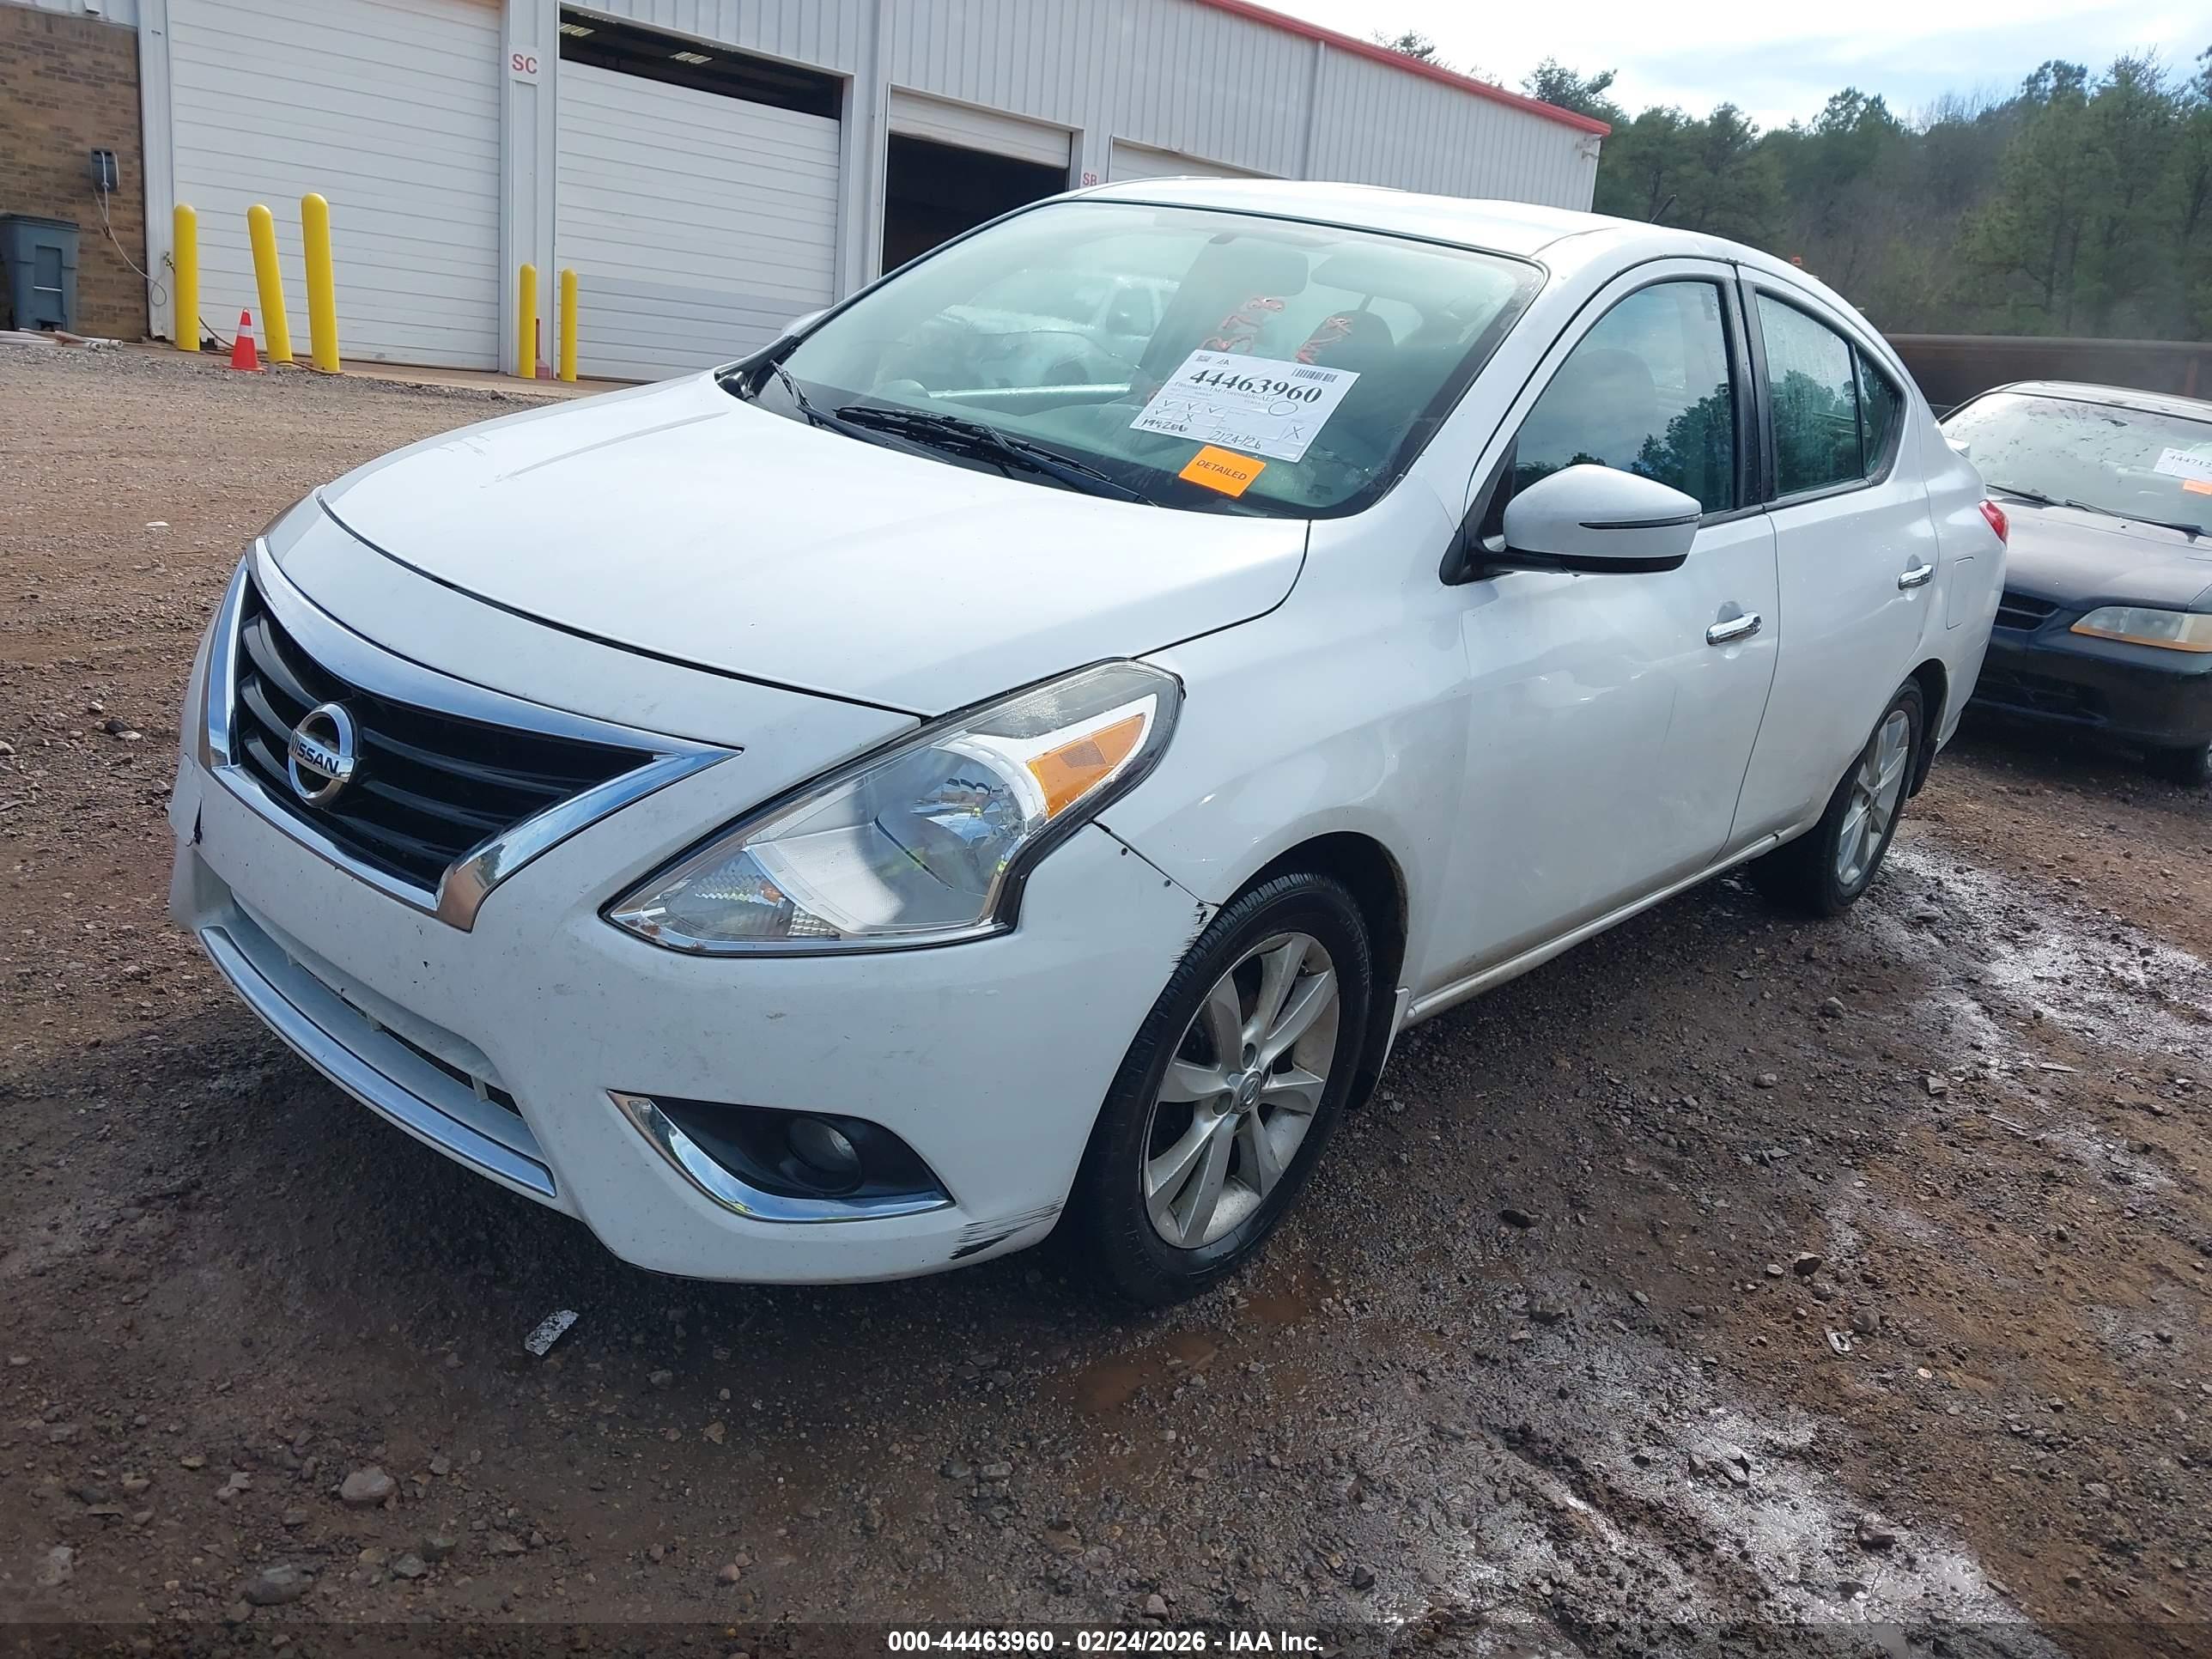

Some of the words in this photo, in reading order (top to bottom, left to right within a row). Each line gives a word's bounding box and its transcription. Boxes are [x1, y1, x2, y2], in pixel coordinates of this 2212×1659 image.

[512, 53, 538, 75] SC
[1083, 172, 1097, 186] SB
[1188, 368, 1323, 404] 44463960
[1196, 459, 1248, 481] DETAILED
[290, 737, 340, 775] NISSAN
